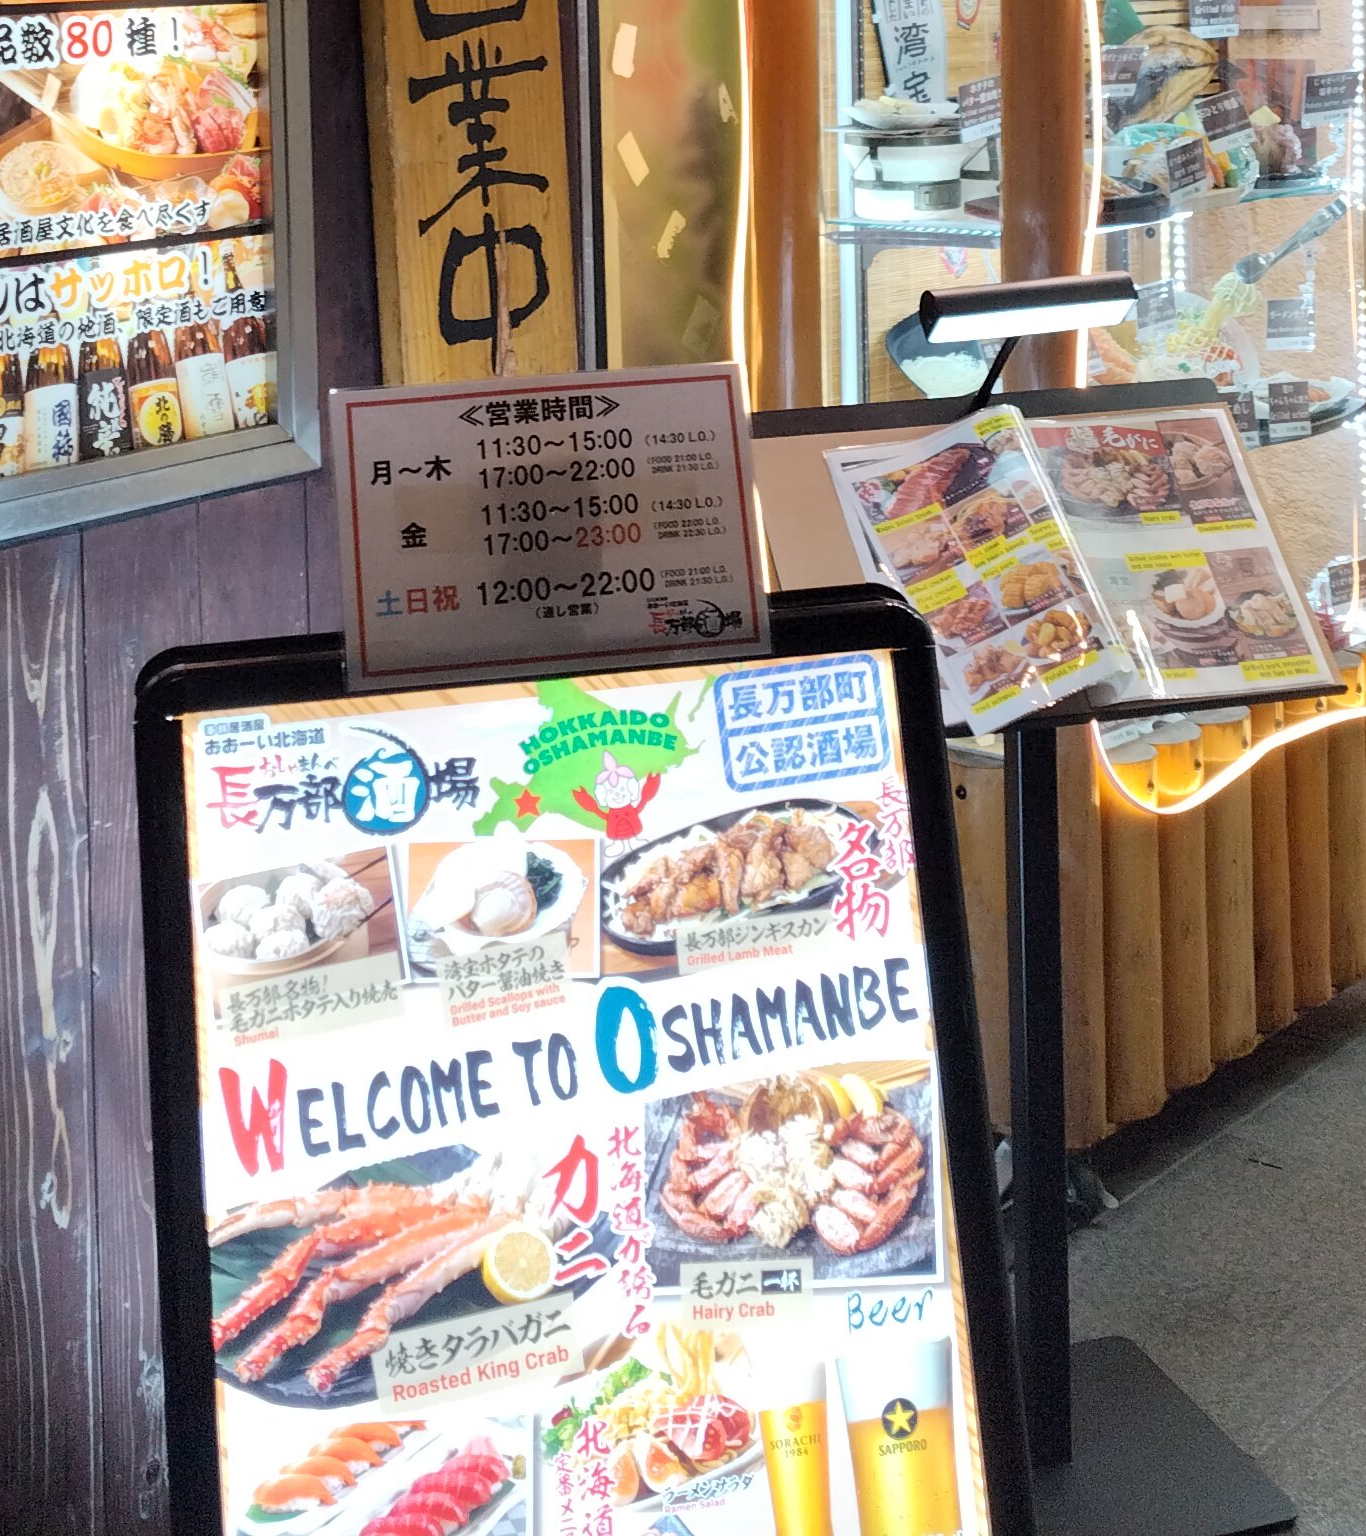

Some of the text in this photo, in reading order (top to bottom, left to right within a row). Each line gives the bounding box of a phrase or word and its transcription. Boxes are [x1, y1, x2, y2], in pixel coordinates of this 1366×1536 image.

[401, 522, 429, 549] 金
[376, 585, 460, 618] 土日祝
[728, 666, 869, 722] 長万部町
[205, 727, 326, 756] おおーい北海道
[518, 709, 670, 757] HOKKAIDO
[258, 751, 340, 778] おしゃまんべ
[521, 732, 678, 776] OSHAMANBE
[735, 724, 878, 779] 公認酒場
[876, 776, 916, 875] 長万部
[827, 822, 891, 941] 名物
[684, 916, 828, 952] 長万部ジンギスカン
[686, 943, 793, 966] Grilled Lamb Meat
[450, 982, 561, 1016] Grilled Scallops with
[451, 994, 566, 1028] Butter and Soy sauce
[233, 1027, 280, 1047] Shumai
[218, 957, 919, 1178] WELCOME TO OSHAMANBE
[542, 1134, 610, 1286] カニ
[692, 1300, 775, 1322] Hairy Crab
[845, 1287, 935, 1335] Beer
[384, 1308, 573, 1379] 焼きタラバガニ
[392, 1345, 571, 1402] Roasted King Crab
[769, 1435, 822, 1451] SORACHI
[783, 1447, 809, 1459] 1984
[877, 1438, 929, 1457] SAPPORO
[662, 1473, 755, 1503] ラーメンサラダ
[663, 1497, 726, 1514] Ramen Salad
